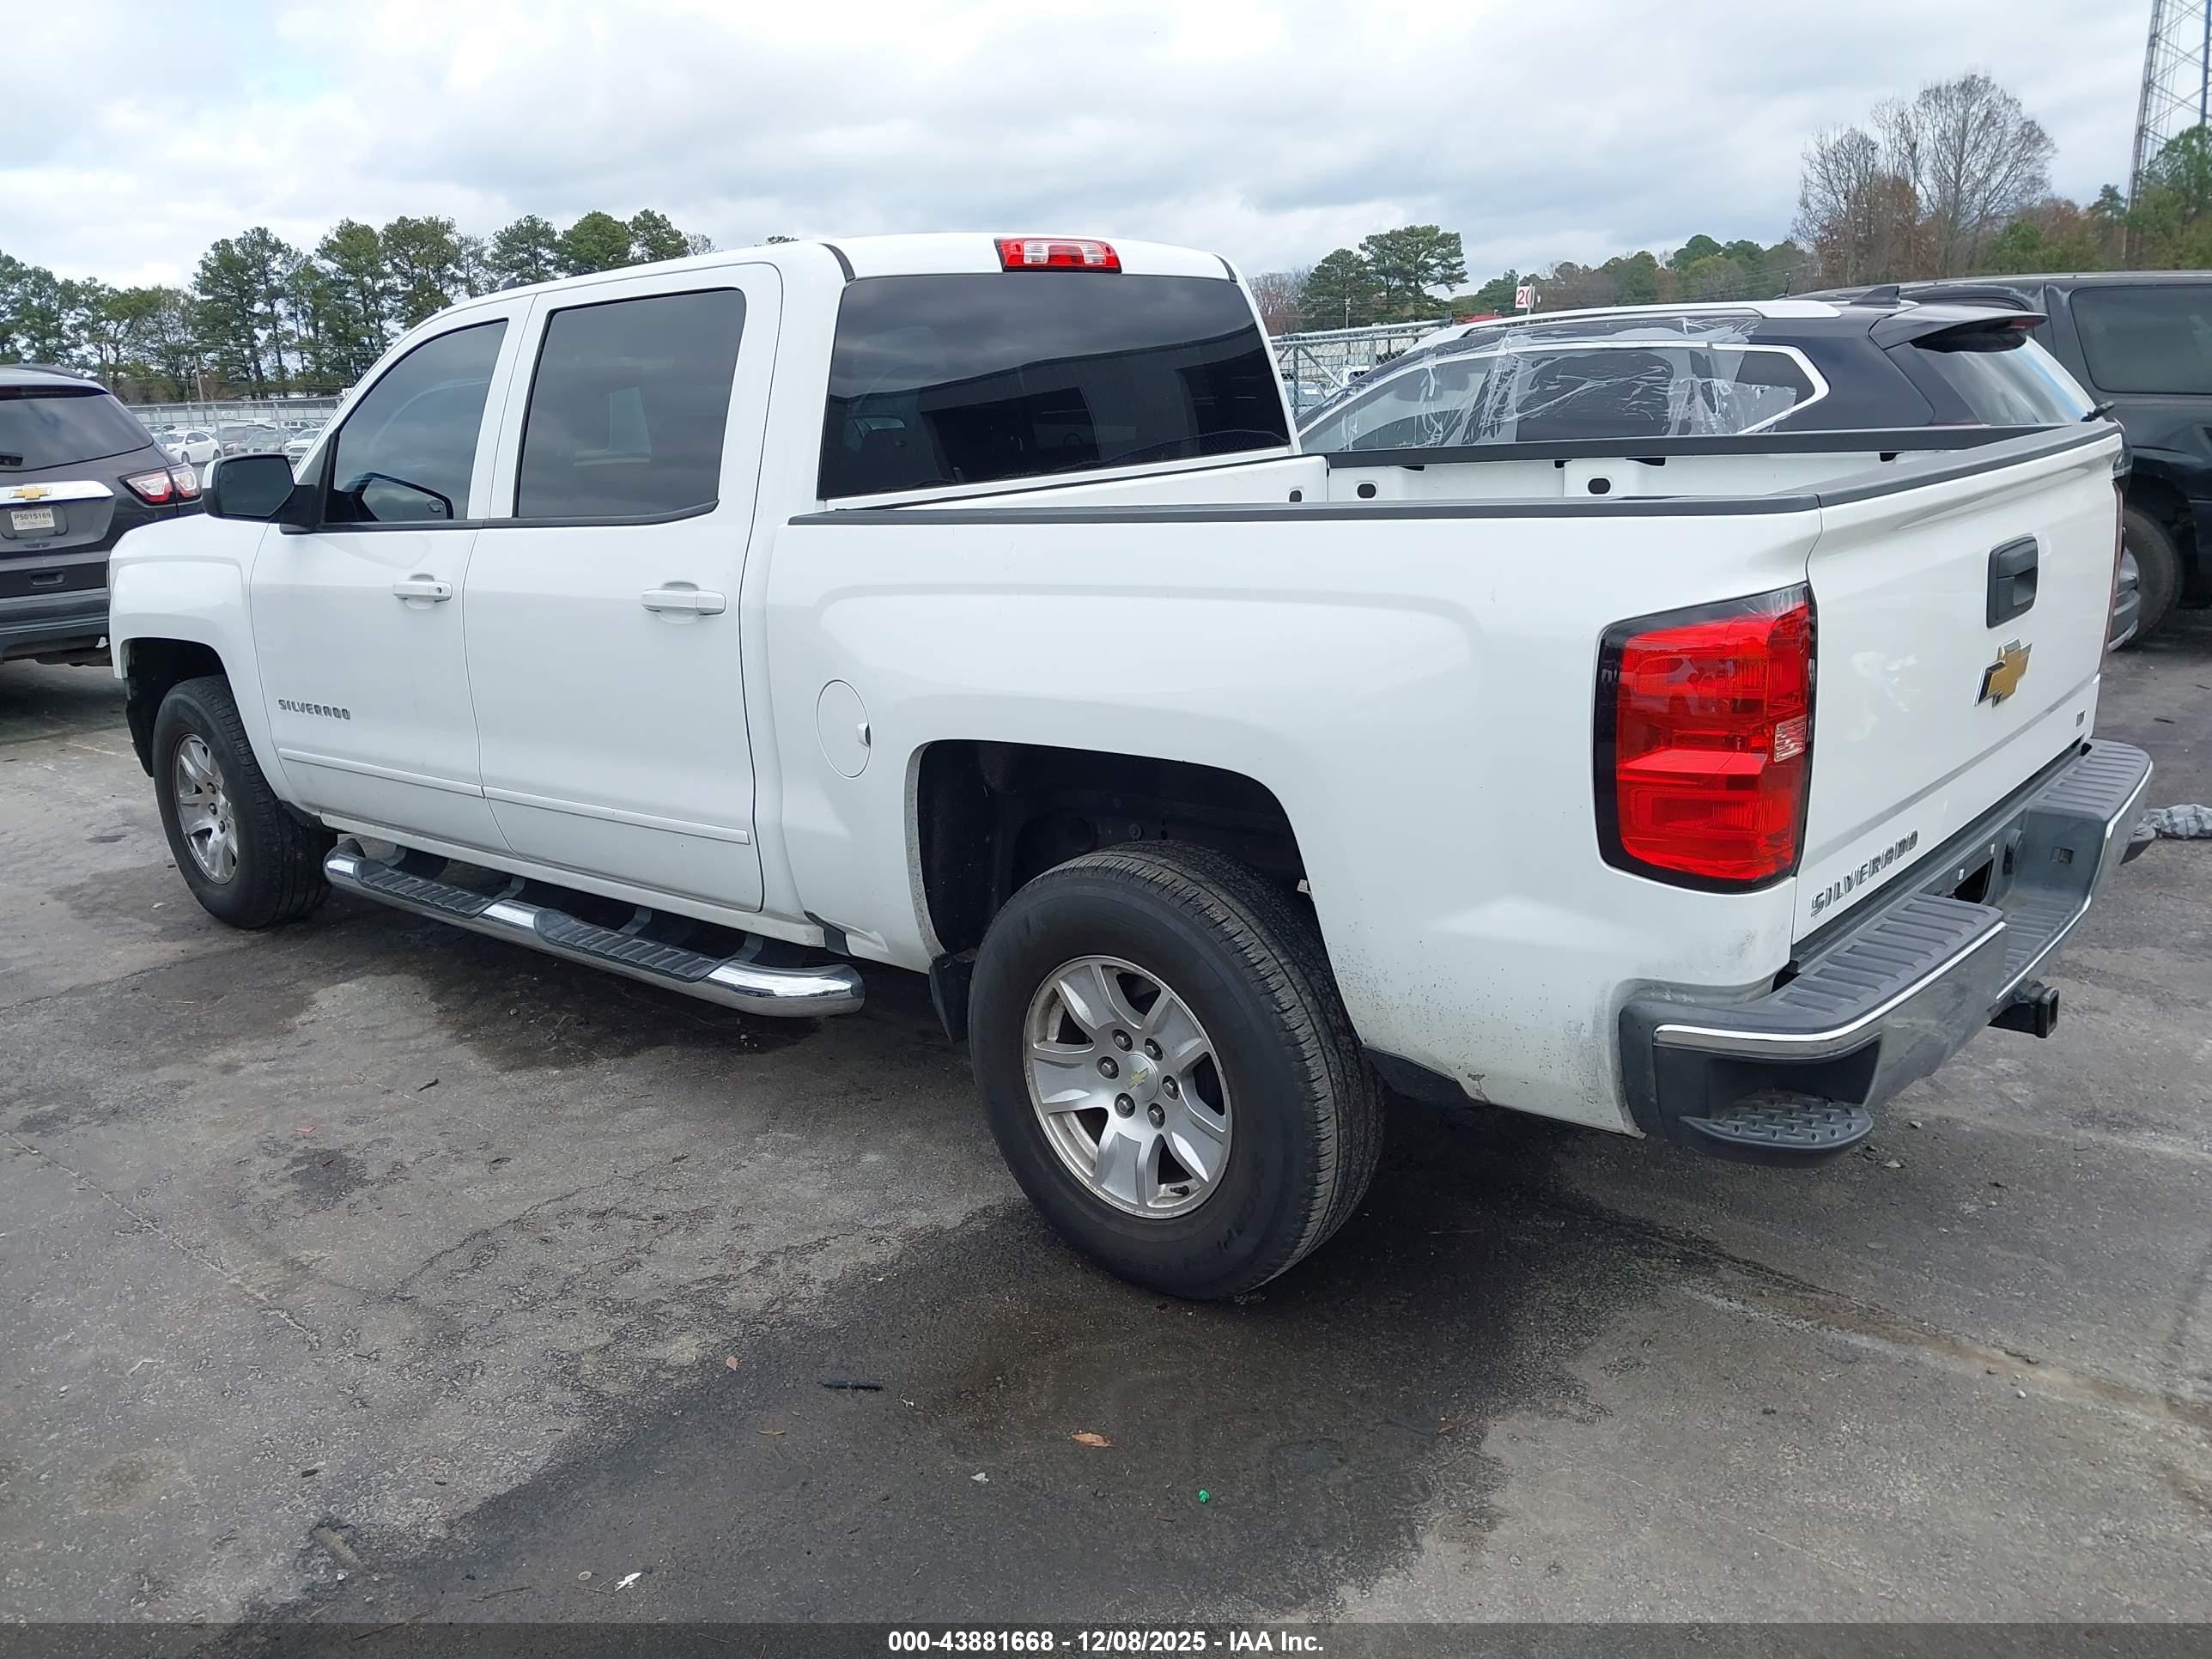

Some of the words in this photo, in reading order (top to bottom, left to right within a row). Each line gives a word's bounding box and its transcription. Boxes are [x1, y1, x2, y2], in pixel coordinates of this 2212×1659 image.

[1516, 289, 1534, 305] 20
[277, 698, 351, 720] SILVERADO
[1810, 830, 1917, 918] SILVERADO
